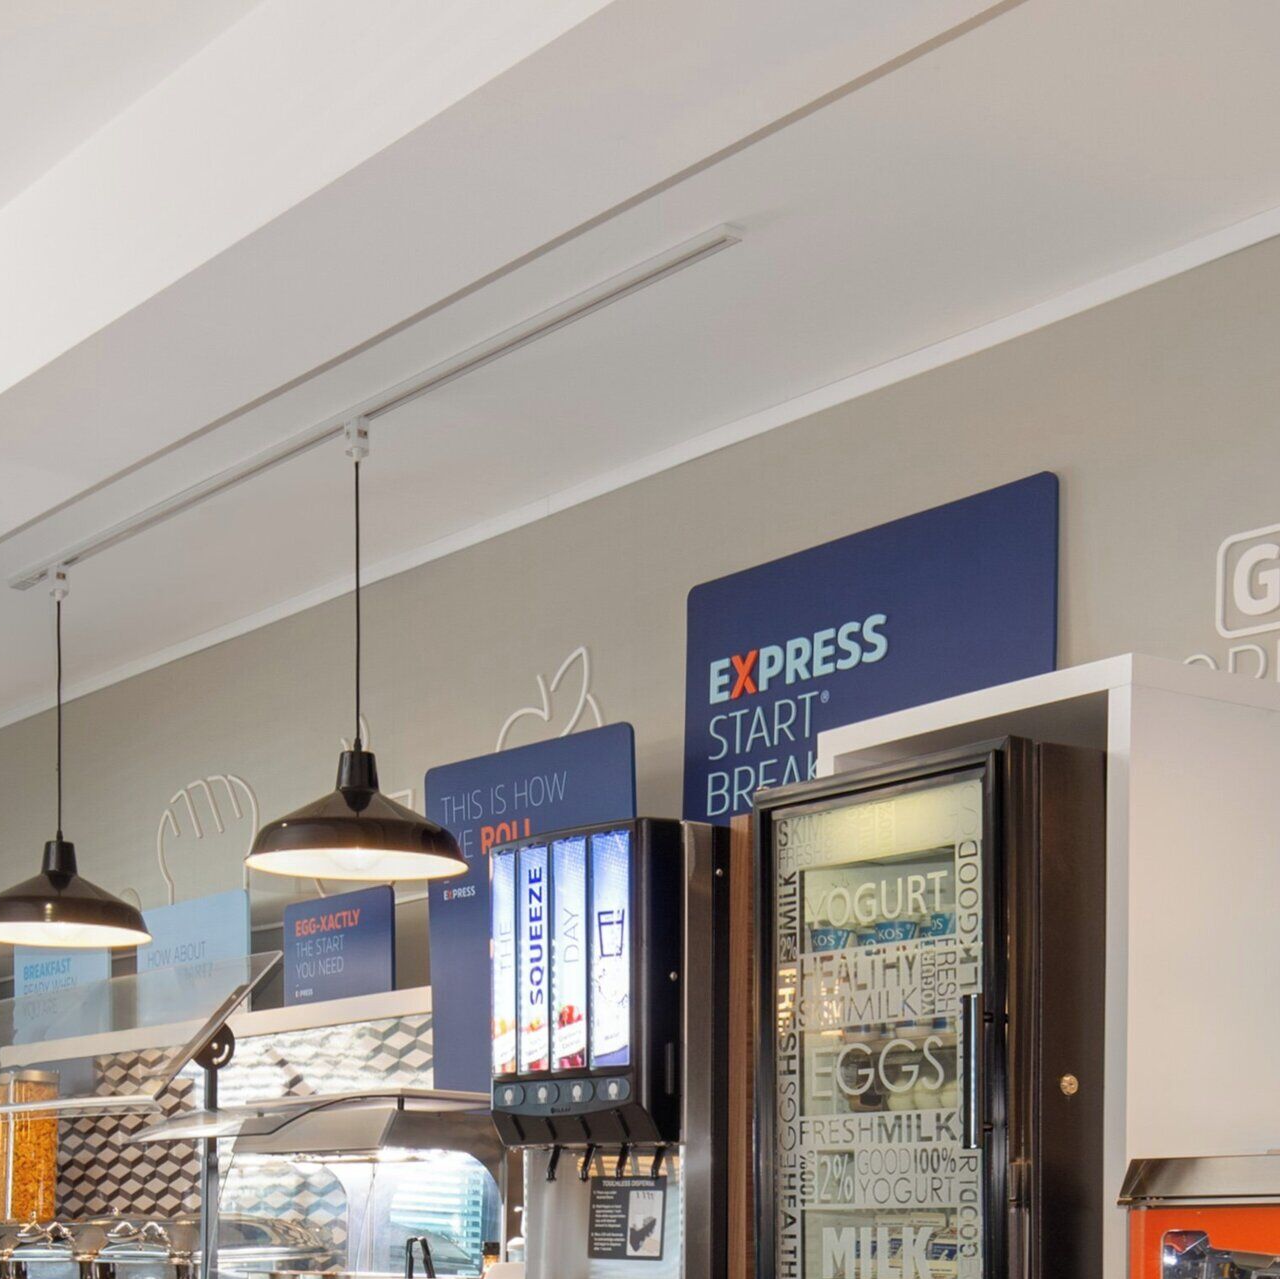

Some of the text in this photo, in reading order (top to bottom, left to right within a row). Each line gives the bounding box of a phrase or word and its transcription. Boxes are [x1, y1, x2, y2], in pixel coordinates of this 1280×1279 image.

[709, 613, 889, 705] EXPRESS
[441, 770, 568, 825] THIS IS HOW
[456, 829, 474, 860] E
[443, 885, 476, 901] EXPRESS
[778, 871, 797, 931] MILK
[804, 870, 949, 929] YOGURT
[958, 839, 980, 933] GOOD
[294, 908, 361, 937] EGG-XACTLY
[295, 934, 345, 958] THE START
[499, 919, 512, 971] THE
[529, 866, 544, 1006] SQUEEZE
[563, 908, 580, 964] DAY
[23, 957, 72, 981] BREAKFAST
[147, 941, 207, 968] HOW ABOUT
[295, 956, 345, 979] YOU NEED
[800, 945, 918, 998] HEALTHY
[921, 938, 936, 1017] YOGURT
[937, 938, 957, 1014] FRESH
[847, 987, 918, 1022] MILK
[810, 1035, 945, 1098] EGGS
[800, 1111, 957, 1146] FRESH MILK
[820, 1153, 854, 1201] 2%
[856, 1149, 910, 1176] GOOD
[913, 1146, 957, 1174] 100%
[858, 1176, 956, 1204] YOGURT
